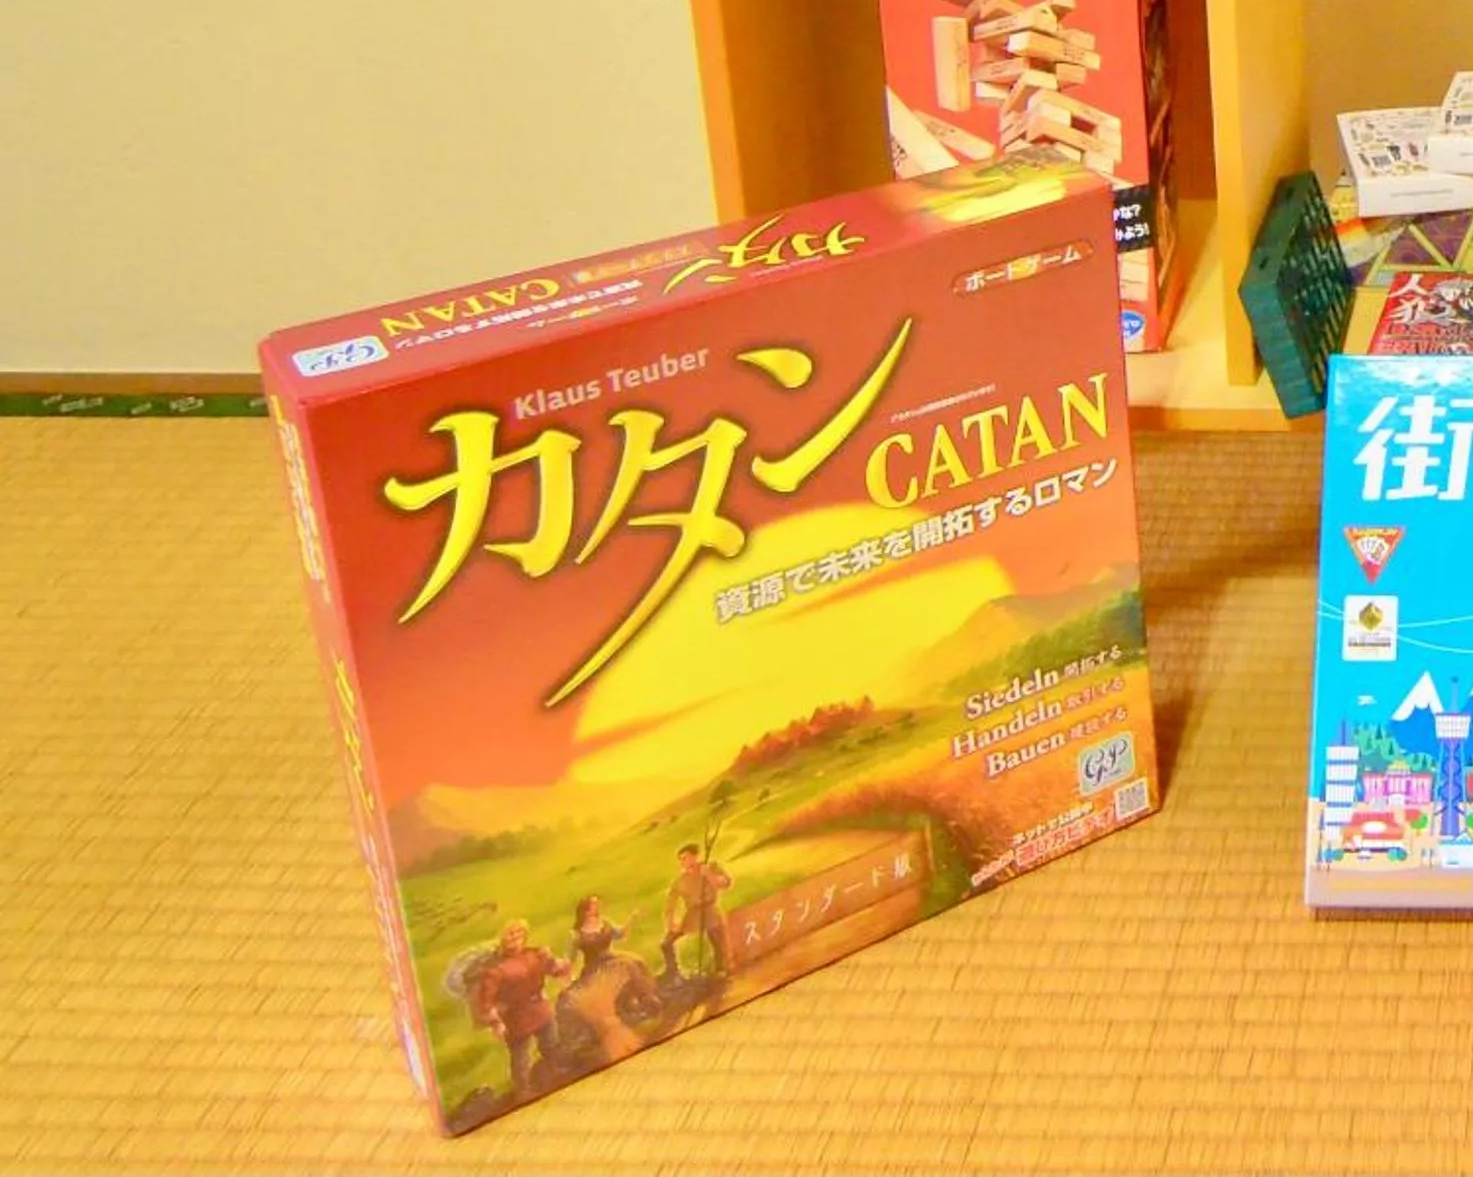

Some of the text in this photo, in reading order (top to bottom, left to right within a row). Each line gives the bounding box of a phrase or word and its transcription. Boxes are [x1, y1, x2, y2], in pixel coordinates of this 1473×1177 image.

[380, 277, 562, 340] CATAN
[513, 347, 711, 421] Klaus Teuber
[865, 372, 1109, 509] CATAN
[384, 316, 913, 707] カタン
[716, 457, 1120, 624] 資源で未来を開拓するロマン
[965, 667, 1061, 719] Siedeln
[951, 700, 1063, 759] Handeln
[986, 732, 1067, 778] Bauen
